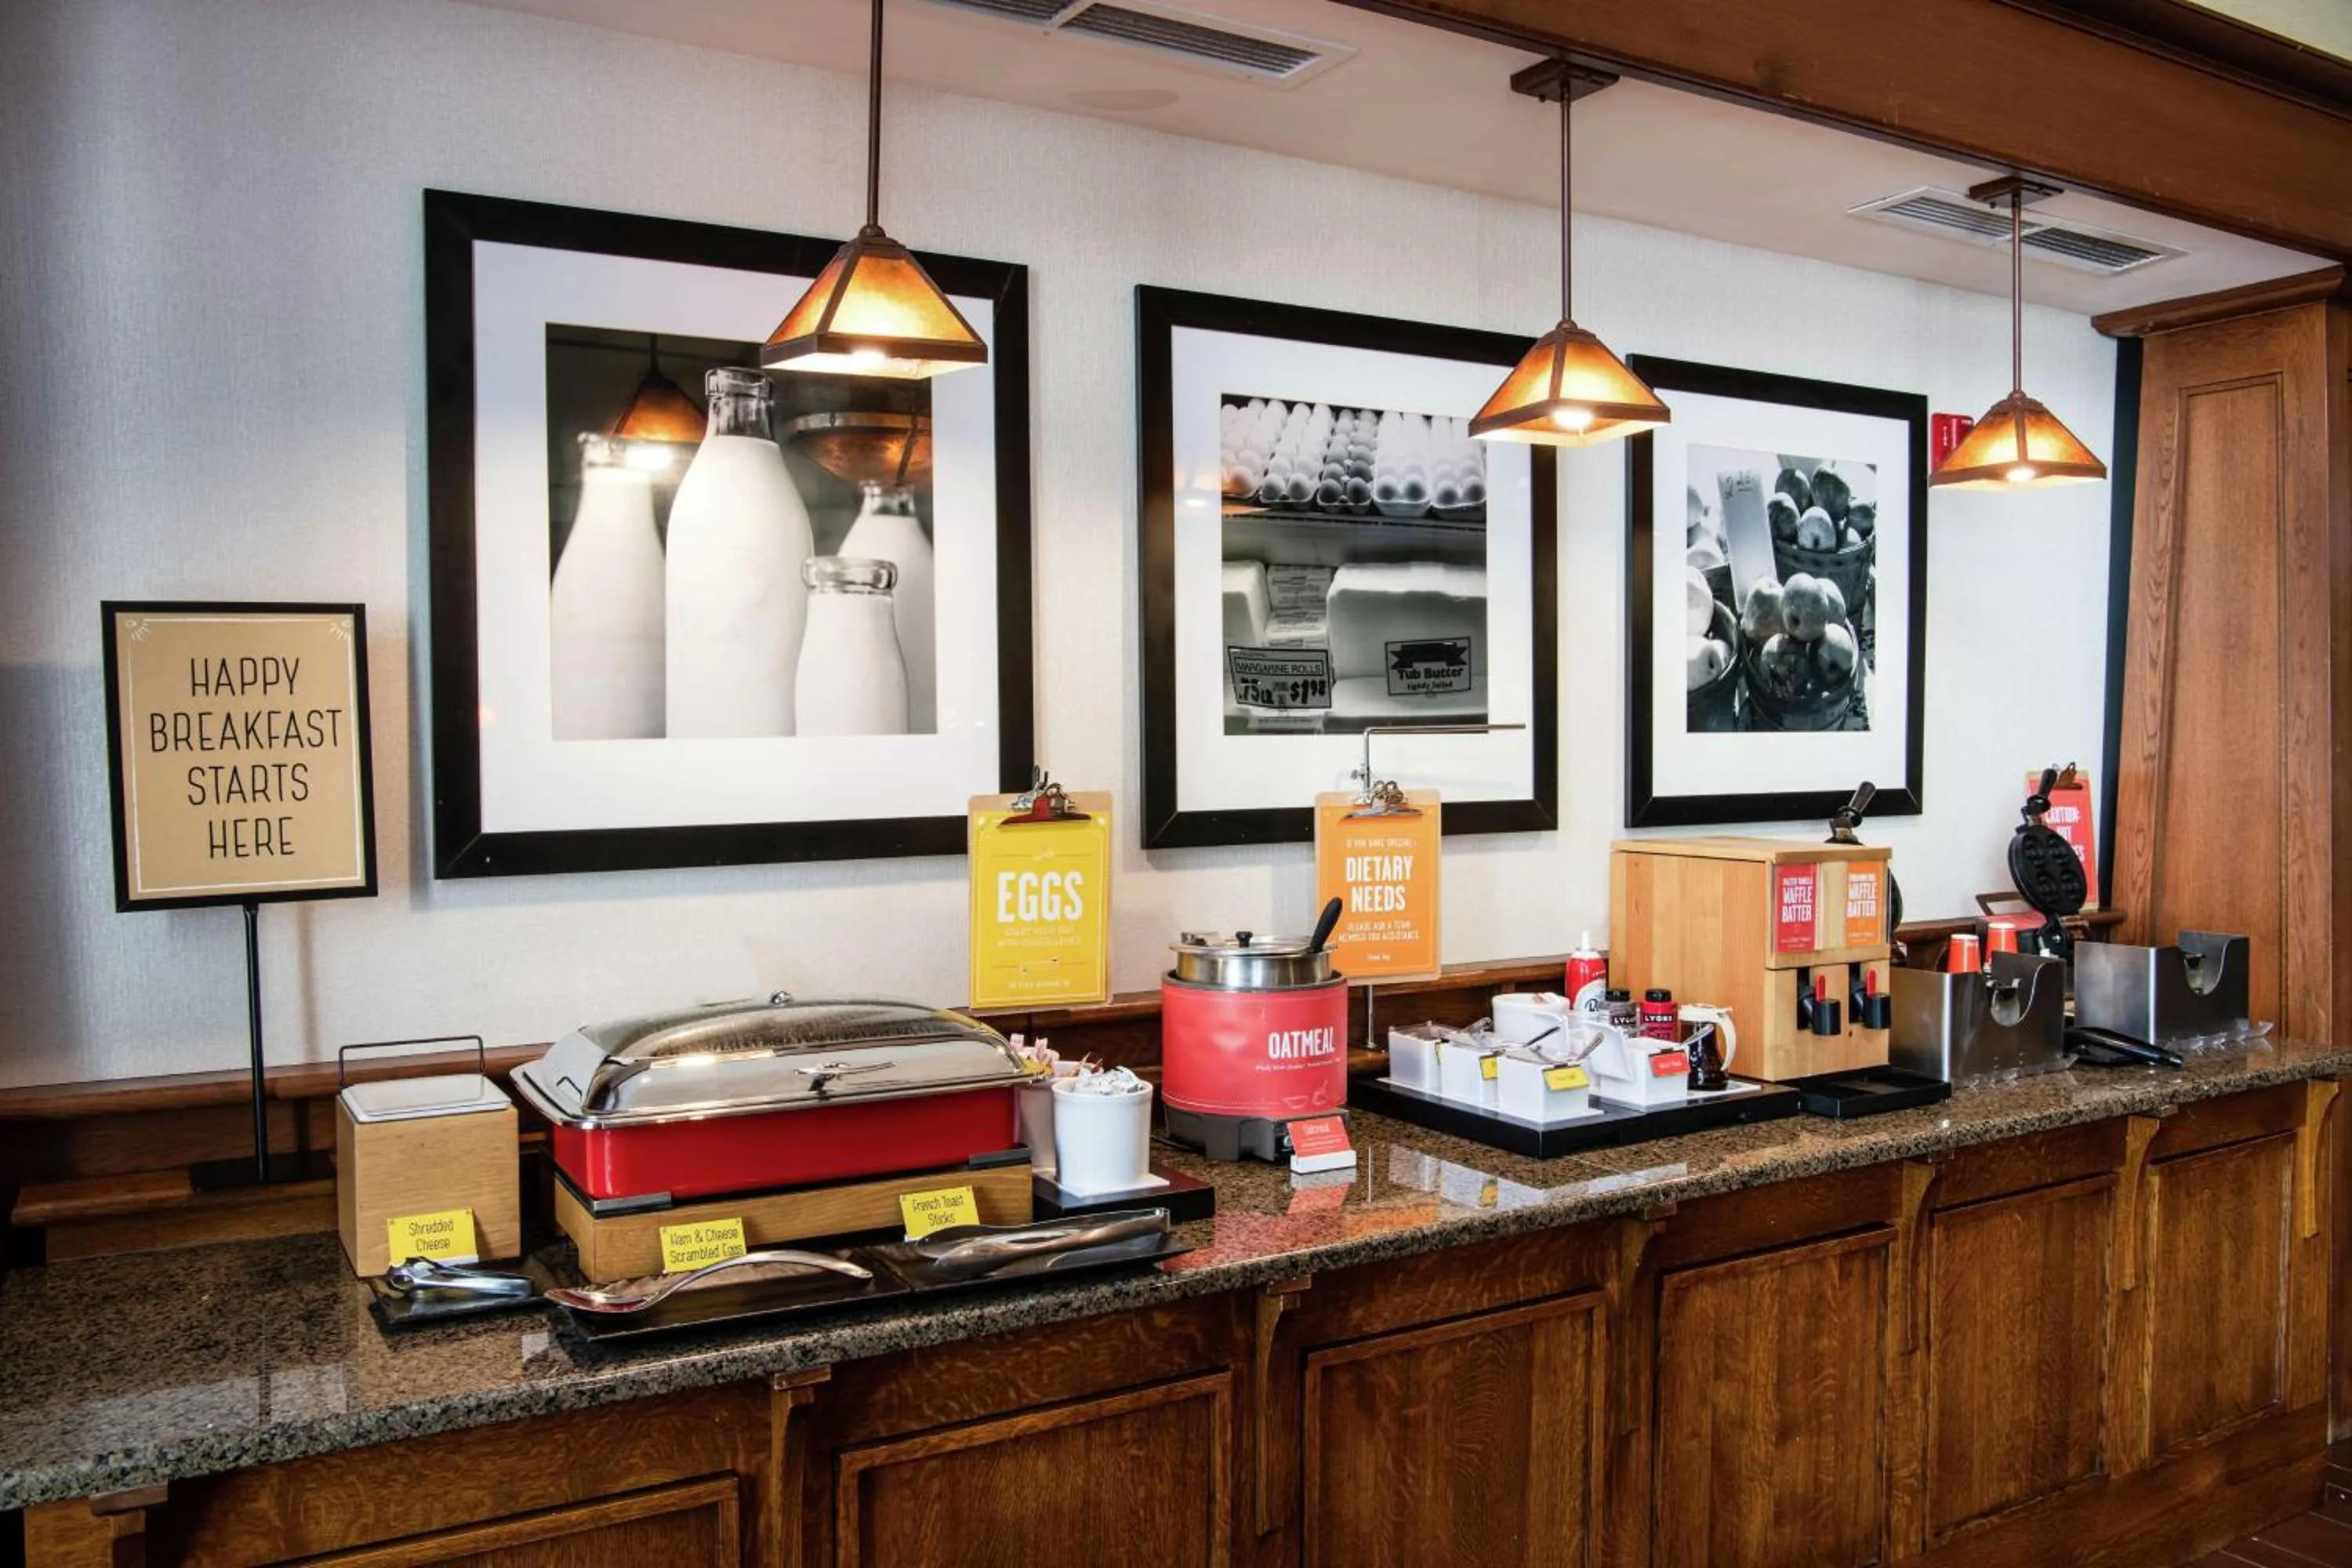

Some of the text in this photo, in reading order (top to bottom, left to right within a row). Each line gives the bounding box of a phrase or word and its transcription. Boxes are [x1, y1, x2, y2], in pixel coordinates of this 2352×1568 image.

[191, 657, 300, 697] HAPPY
[1236, 661, 1322, 674] MARGARINE ROLLS
[1397, 666, 1464, 681] Tub Butter
[150, 709, 343, 753] BREAKFAST
[187, 763, 309, 806] STARTS
[209, 816, 296, 859] HERE
[1345, 855, 1414, 883] DIETARY
[997, 870, 1083, 924] EGGS
[1351, 885, 1406, 913] NEEDS
[1783, 886, 1813, 904] WAFFLE
[1849, 882, 1876, 900] WAFFLE
[1781, 904, 1813, 923] BATTER
[1268, 1026, 1336, 1060] OATMEAL
[913, 1194, 964, 1212] French Toast
[408, 1218, 454, 1236] Shredded
[927, 1212, 955, 1227] Sticks
[416, 1238, 451, 1252] Cheese
[671, 1225, 739, 1245] Ham & Cheese
[670, 1242, 744, 1264] Scrambled Eggs
